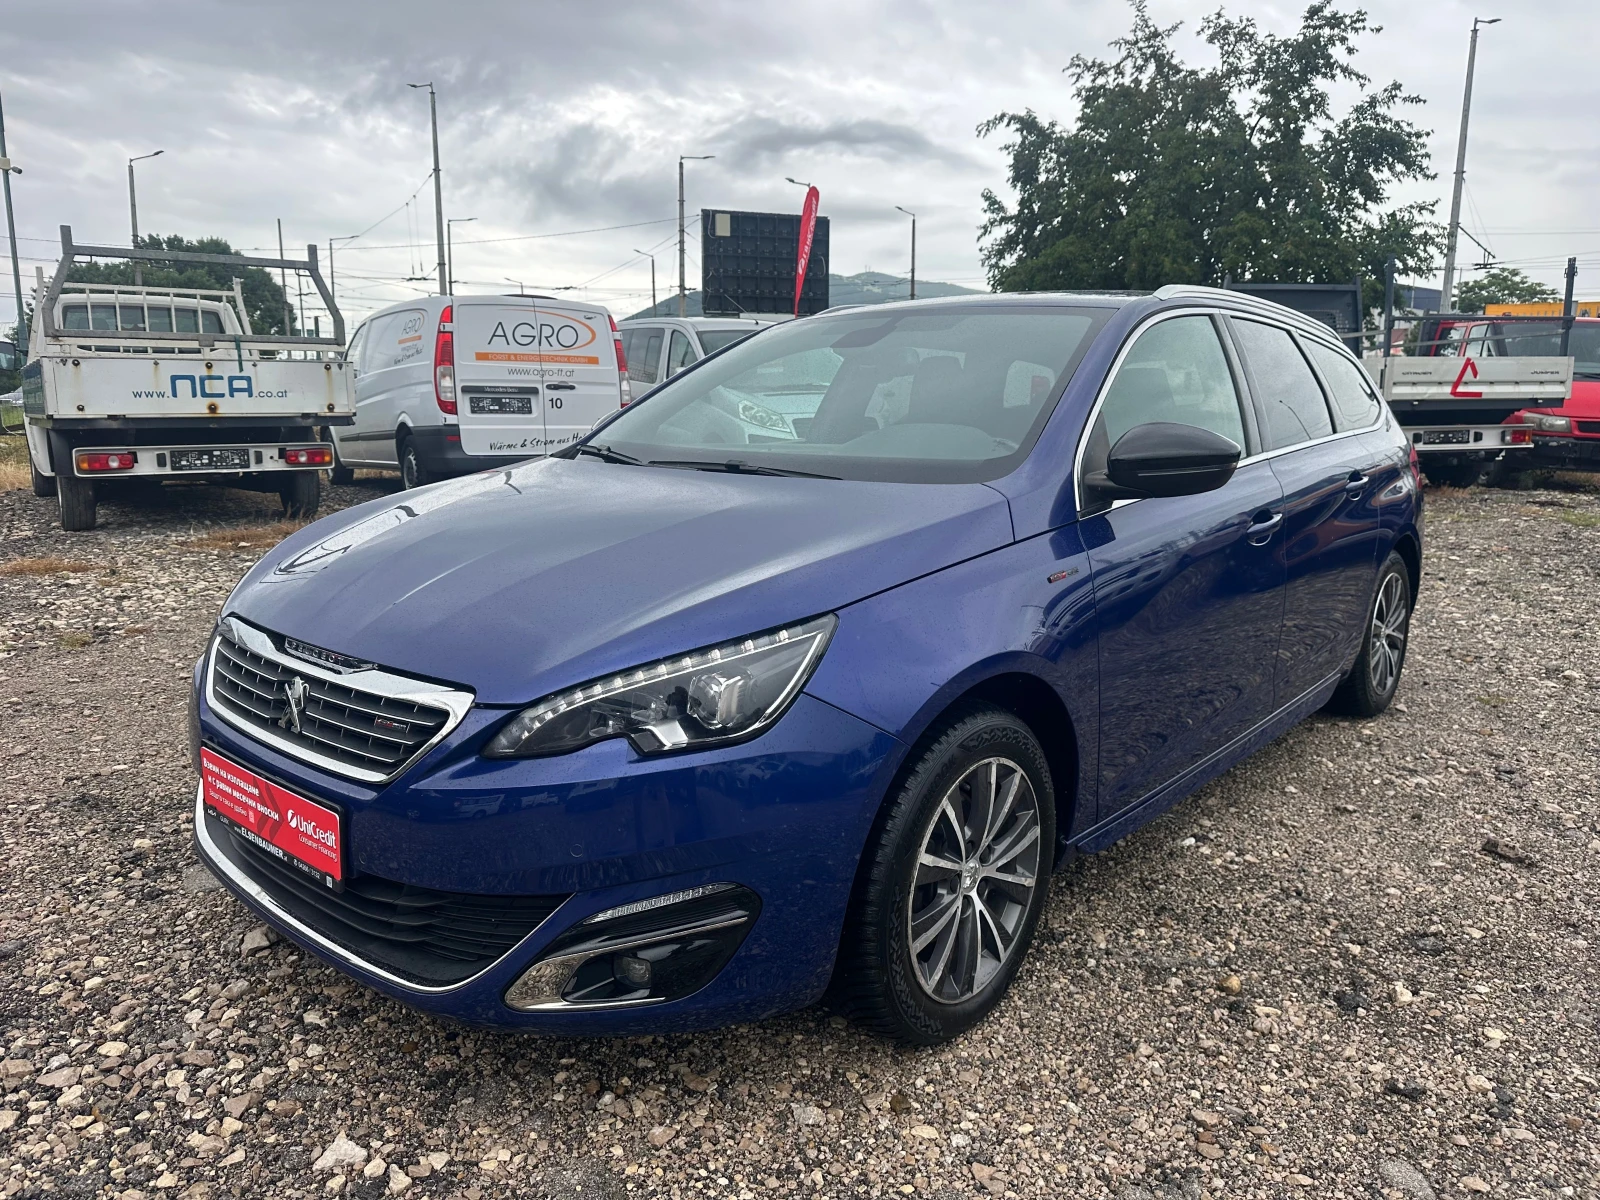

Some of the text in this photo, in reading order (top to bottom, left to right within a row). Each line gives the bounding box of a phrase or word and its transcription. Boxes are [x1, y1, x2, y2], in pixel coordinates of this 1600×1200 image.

[487, 321, 579, 349] AGRO
[489, 353, 508, 361] FORST
[507, 367, 575, 378] www.agro-ft.at
[548, 397, 563, 409] 10
[489, 441, 518, 451] Wärme
[520, 438, 527, 448] &
[530, 437, 555, 448] Strom
[572, 432, 587, 442] Ho
[219, 768, 227, 778] на
[256, 802, 279, 821] вноски
[297, 814, 337, 850] UniCredit
[298, 833, 318, 850] Consumer
